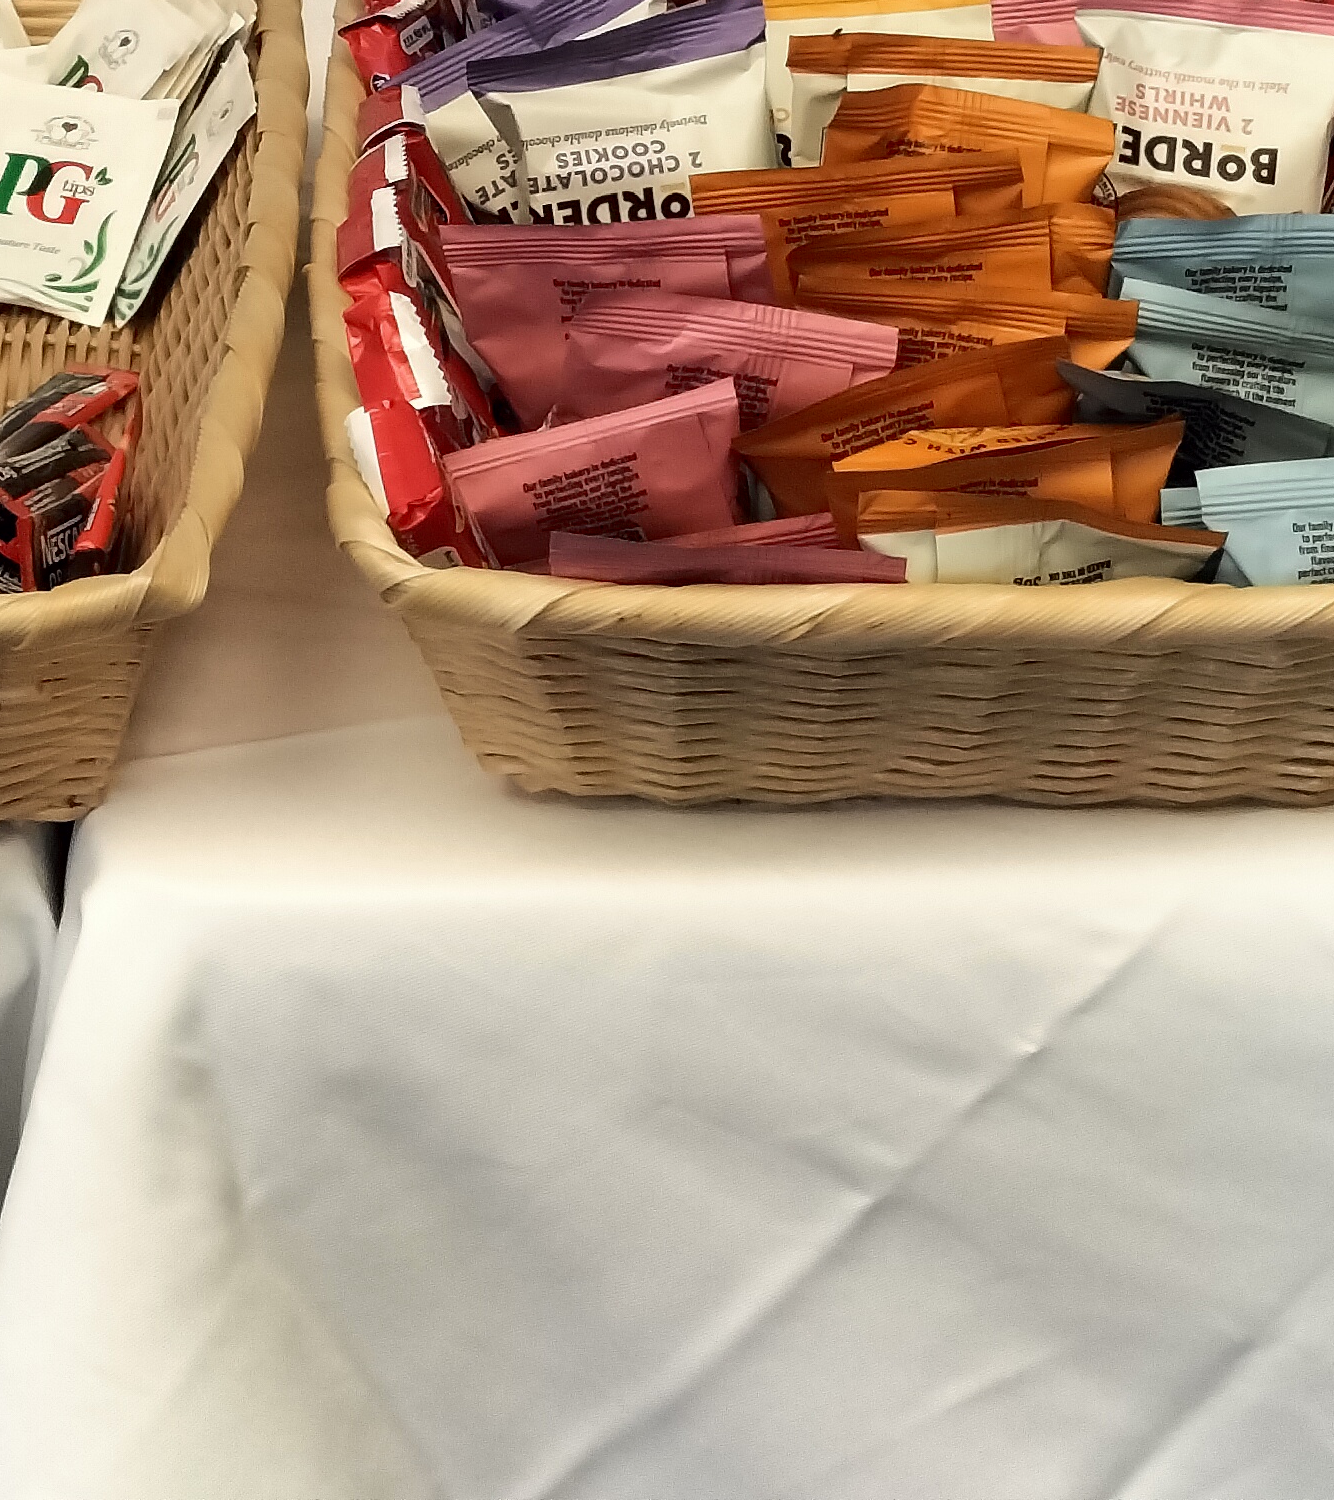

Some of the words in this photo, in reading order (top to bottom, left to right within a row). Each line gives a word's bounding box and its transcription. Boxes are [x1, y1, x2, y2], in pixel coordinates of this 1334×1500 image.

[1135, 83, 1232, 113] WHIRLS
[1114, 95, 1232, 134] VIENNESE
[1241, 118, 1255, 136] 2
[555, 139, 667, 170] COOKIES
[687, 150, 704, 169] 2
[1113, 121, 1280, 186] BORDE
[62, 180, 97, 197] tips
[527, 155, 681, 195] CHOCOLATE
